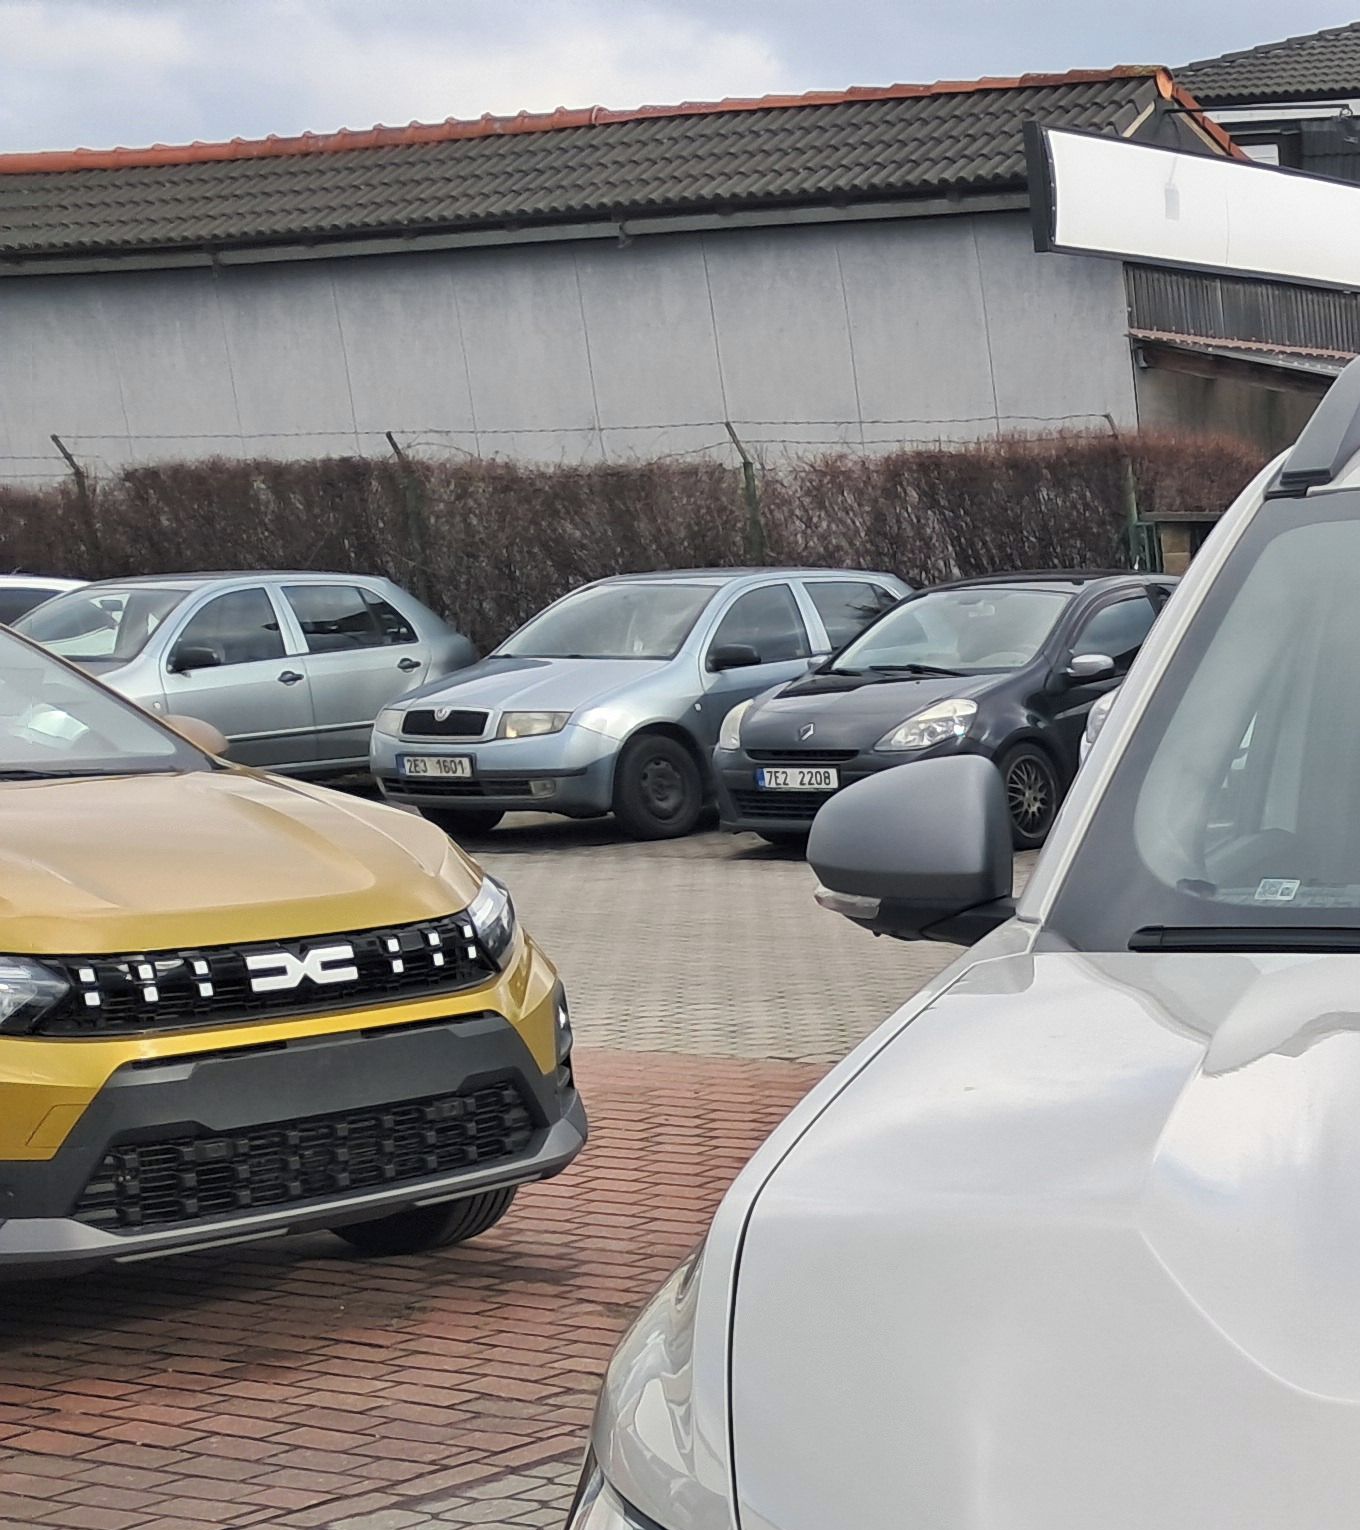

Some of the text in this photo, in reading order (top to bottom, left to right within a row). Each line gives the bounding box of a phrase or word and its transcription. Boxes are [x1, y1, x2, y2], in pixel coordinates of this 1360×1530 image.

[435, 759, 465, 774] 1601
[766, 770, 831, 786] 7E2 2208
